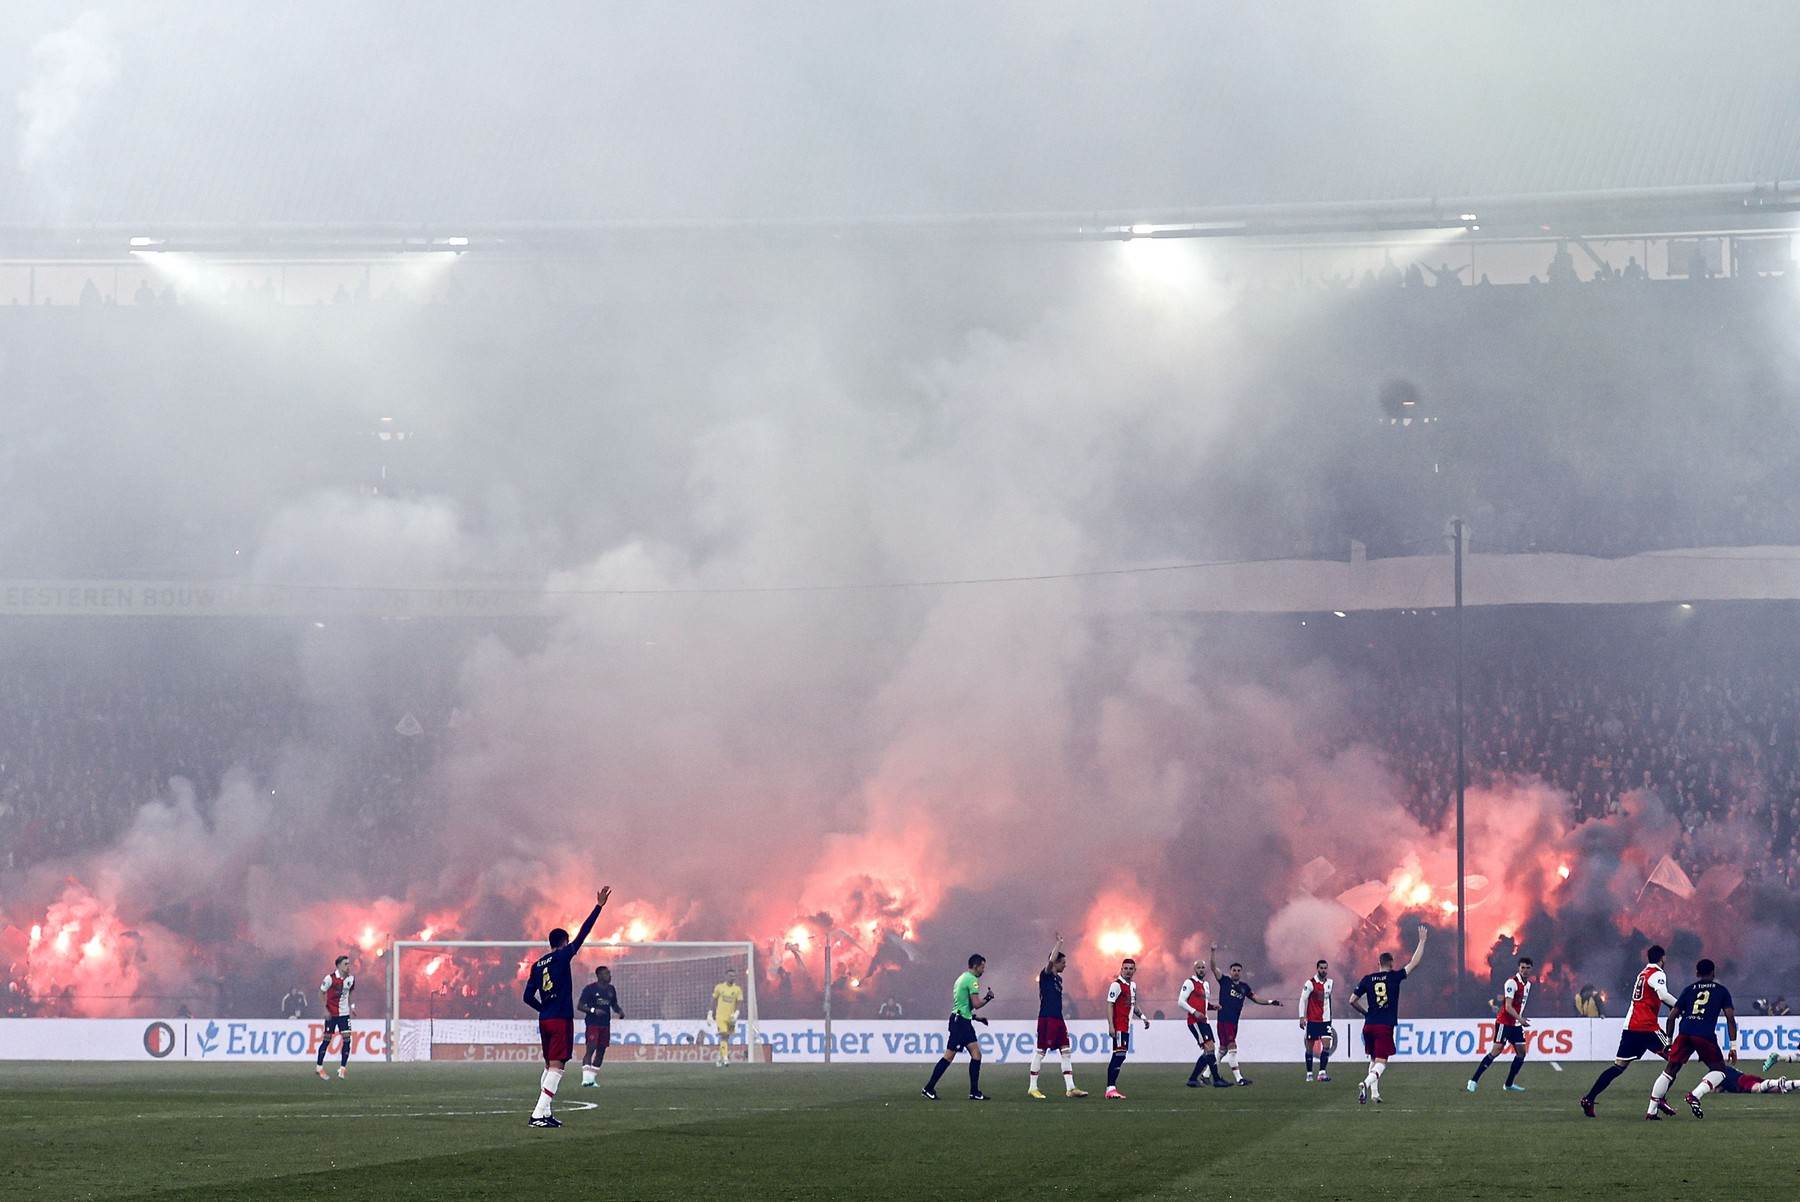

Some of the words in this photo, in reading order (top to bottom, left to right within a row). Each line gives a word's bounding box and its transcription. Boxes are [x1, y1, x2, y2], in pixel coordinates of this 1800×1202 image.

[4, 586, 133, 607] EESTEREN
[1692, 990, 1710, 1015] 2
[882, 1031, 944, 1055] van
